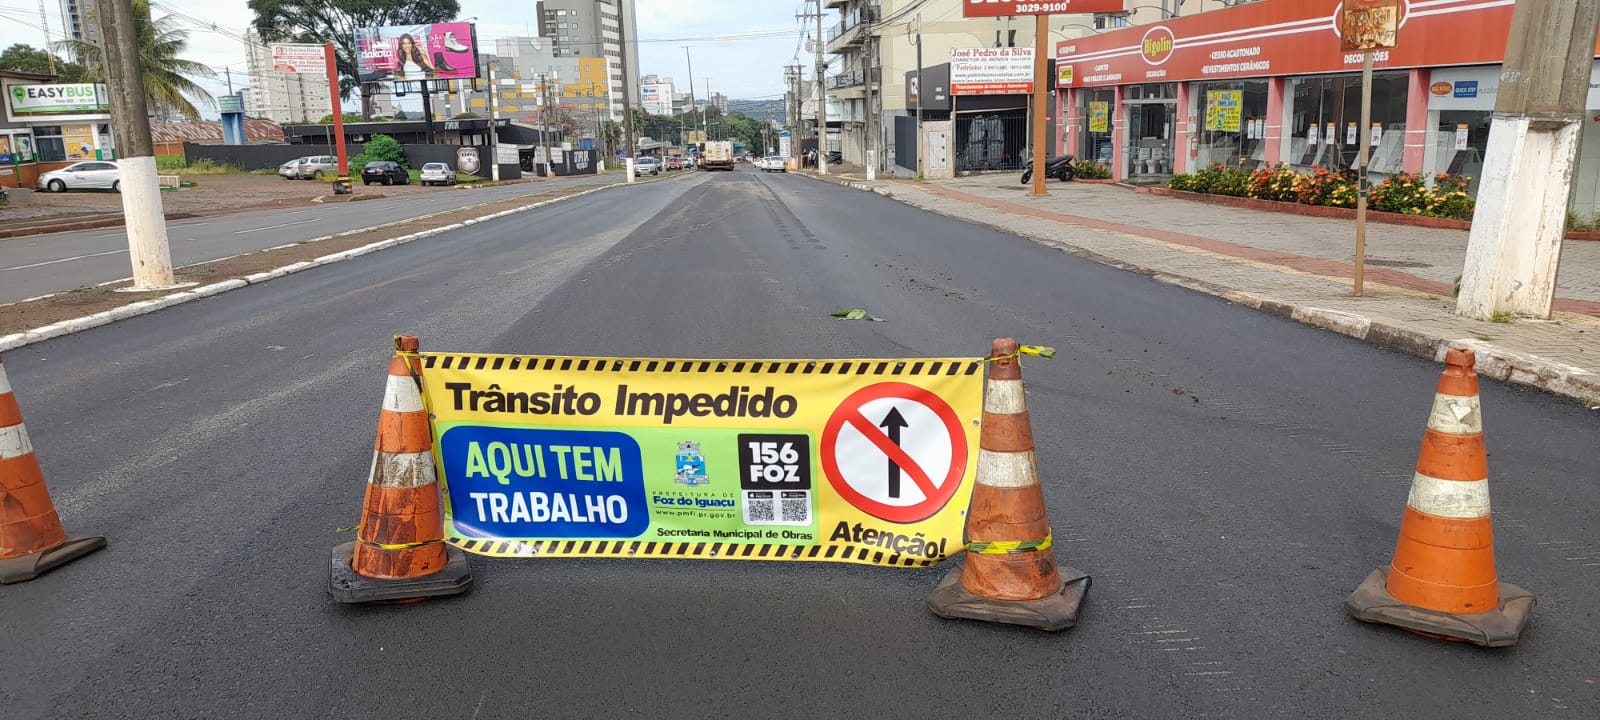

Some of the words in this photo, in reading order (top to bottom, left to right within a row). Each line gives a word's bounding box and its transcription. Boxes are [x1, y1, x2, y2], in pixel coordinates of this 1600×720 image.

[1015, 3, 1067, 13] 3029-9100
[361, 49, 393, 58] dakota
[952, 48, 971, 57] José
[973, 48, 997, 57] Pedro
[1000, 48, 1009, 56] da
[1011, 47, 1032, 56] Silva
[1144, 36, 1171, 57] Bigolin
[1227, 46, 1261, 58] ACARTONADO
[1240, 60, 1270, 72] CERÂMICOS
[445, 382, 602, 416] Trânsito
[614, 384, 798, 425] Impedido
[748, 441, 799, 464] 156
[465, 441, 547, 485] AQUI
[550, 444, 624, 482] TEM
[749, 464, 800, 483] FOZ
[652, 490, 716, 498] PREFEITURA
[469, 491, 629, 524] TRABALHO
[653, 495, 675, 505] Foz
[677, 496, 693, 505] do
[695, 497, 736, 508] Iguaçu
[655, 510, 737, 519] www.pmfi.pr.gov.br
[656, 527, 711, 539] Secretaria
[713, 529, 764, 542] Municipal
[765, 530, 780, 540] de
[781, 530, 813, 541] Obras
[829, 521, 947, 559] Atenção!
